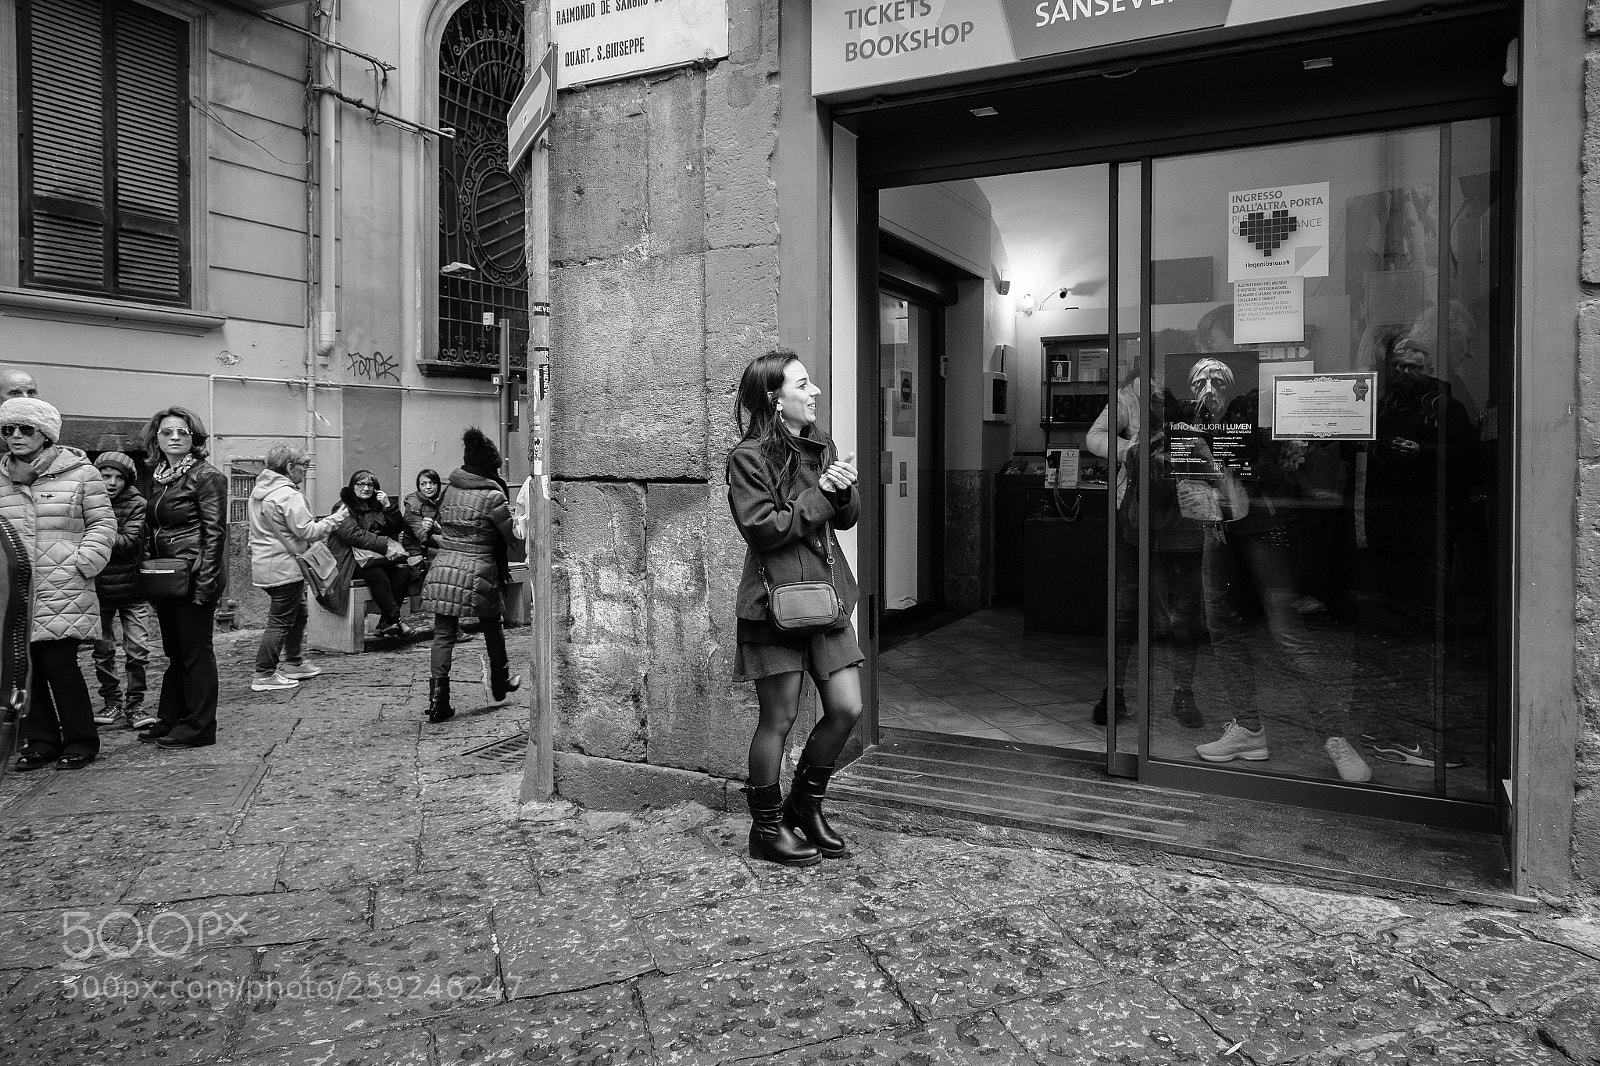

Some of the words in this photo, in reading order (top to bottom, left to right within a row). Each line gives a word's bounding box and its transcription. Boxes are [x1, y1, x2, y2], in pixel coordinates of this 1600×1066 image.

[556, 2, 596, 26] RAIMONDO
[600, 2, 611, 15] DE
[844, 0, 932, 30] TICKETS
[844, 20, 974, 62] BOOKSHOP
[564, 47, 595, 68] QUART.
[1232, 190, 1283, 204] INGRESSO
[1232, 200, 1288, 214] DALL'ALTRA
[1290, 197, 1324, 208] PORTA
[1170, 423, 1189, 431] NINO
[1190, 423, 1222, 431] MIGLIORI
[1226, 423, 1252, 431] LUMEN
